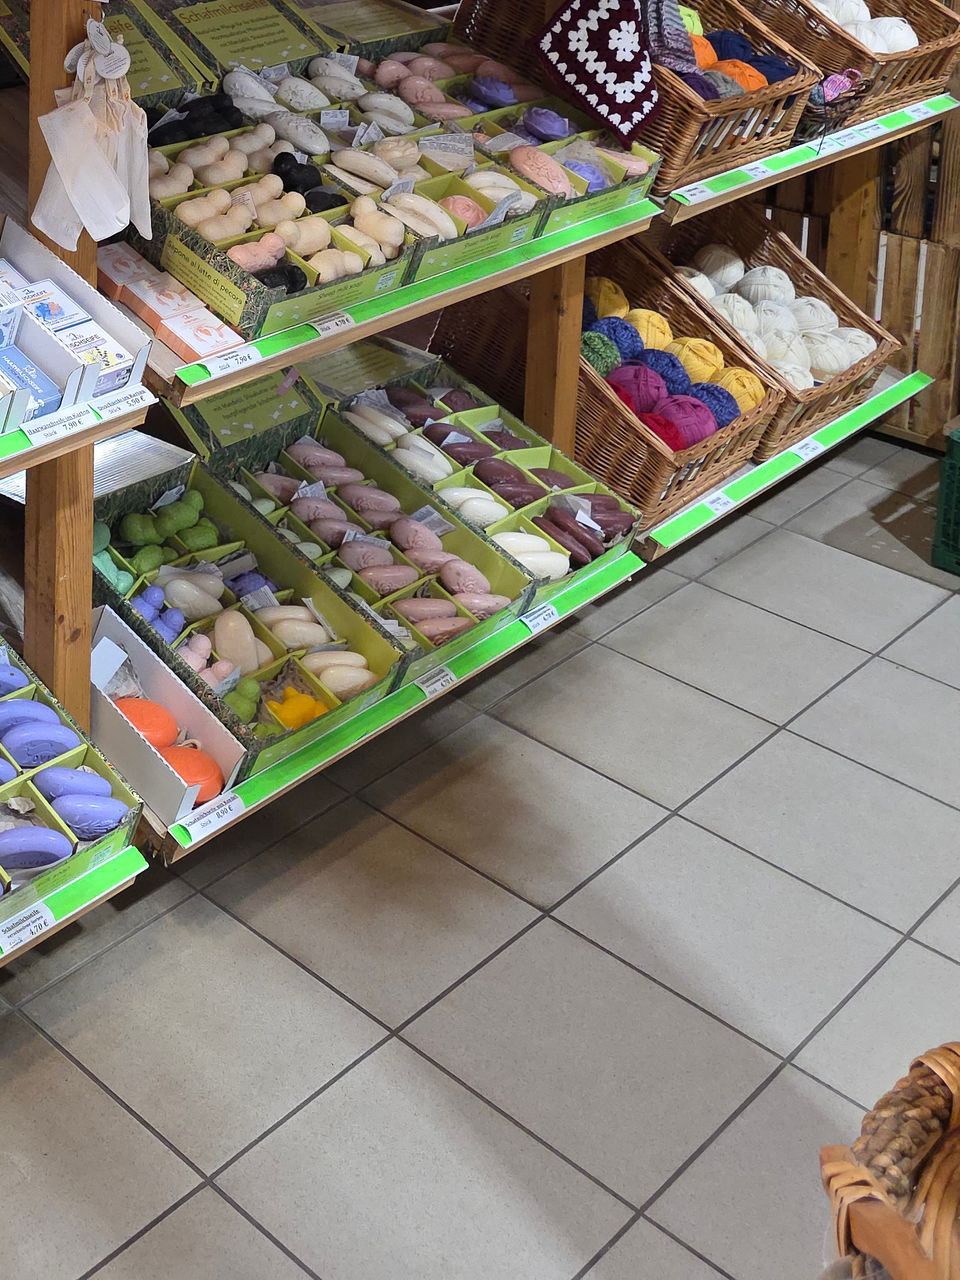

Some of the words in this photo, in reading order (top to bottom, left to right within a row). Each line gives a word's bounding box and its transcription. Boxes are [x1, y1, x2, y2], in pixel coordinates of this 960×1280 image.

[1, 354, 44, 395] HAARWASCHSEIFE
[108, 406, 122, 415] Stück
[126, 398, 140, 407] 5,90
[27, 417, 64, 435] Haarwaschseife
[72, 409, 91, 420] Karton
[43, 430, 58, 439] Stück
[62, 421, 78, 431] 7,90
[1, 909, 40, 934] Schafmilchseife
[29, 922, 43, 936] 4,70
[43, 919, 49, 927] €
